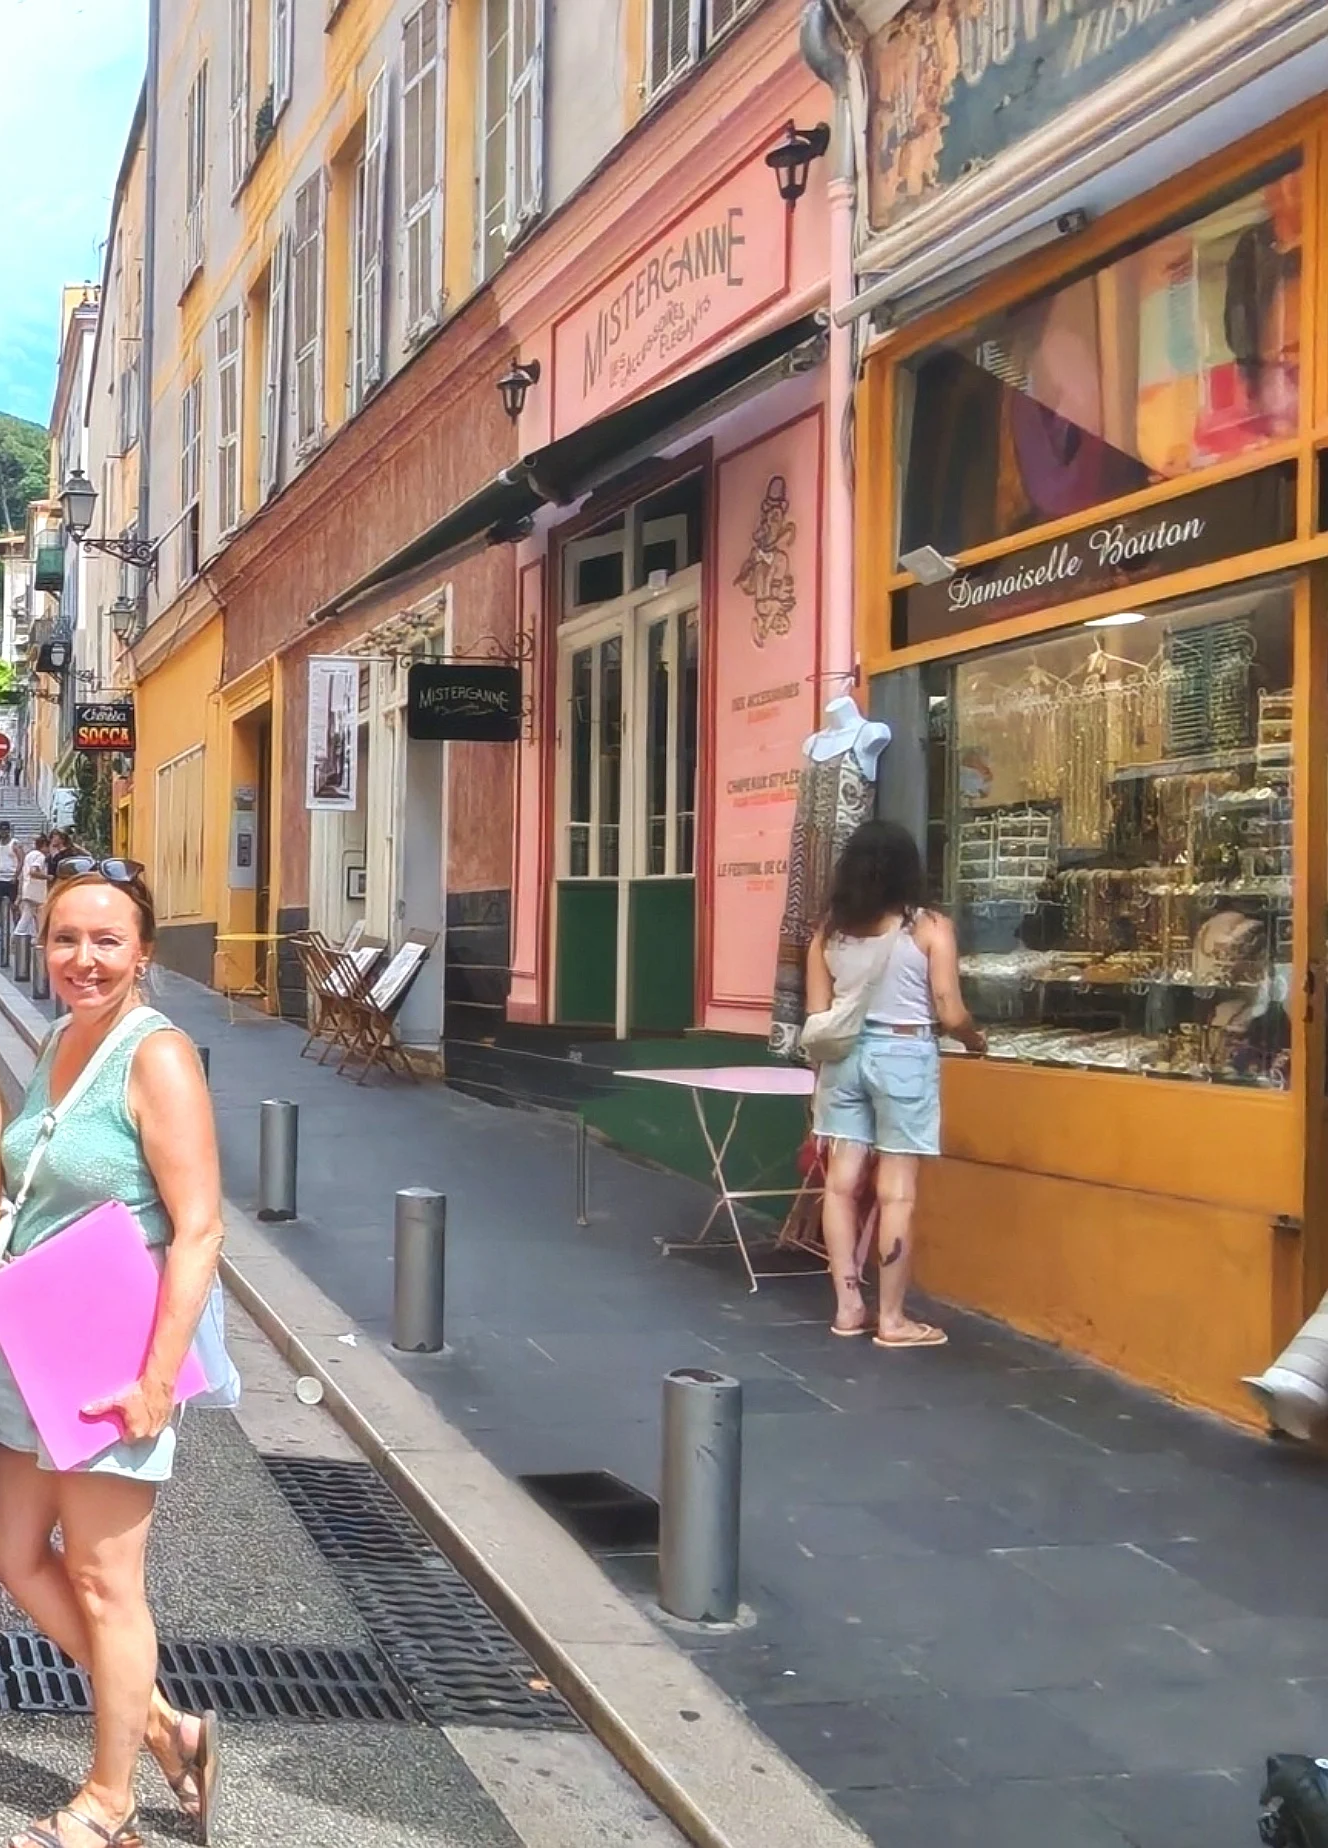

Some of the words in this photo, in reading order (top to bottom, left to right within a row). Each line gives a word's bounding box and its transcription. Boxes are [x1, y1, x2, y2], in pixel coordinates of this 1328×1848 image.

[947, 541, 1083, 612] Damoiselle
[1088, 516, 1206, 567] Bouton
[78, 726, 131, 745] SOCCA
[717, 863, 727, 877] LE
[776, 859, 788, 875] CA
